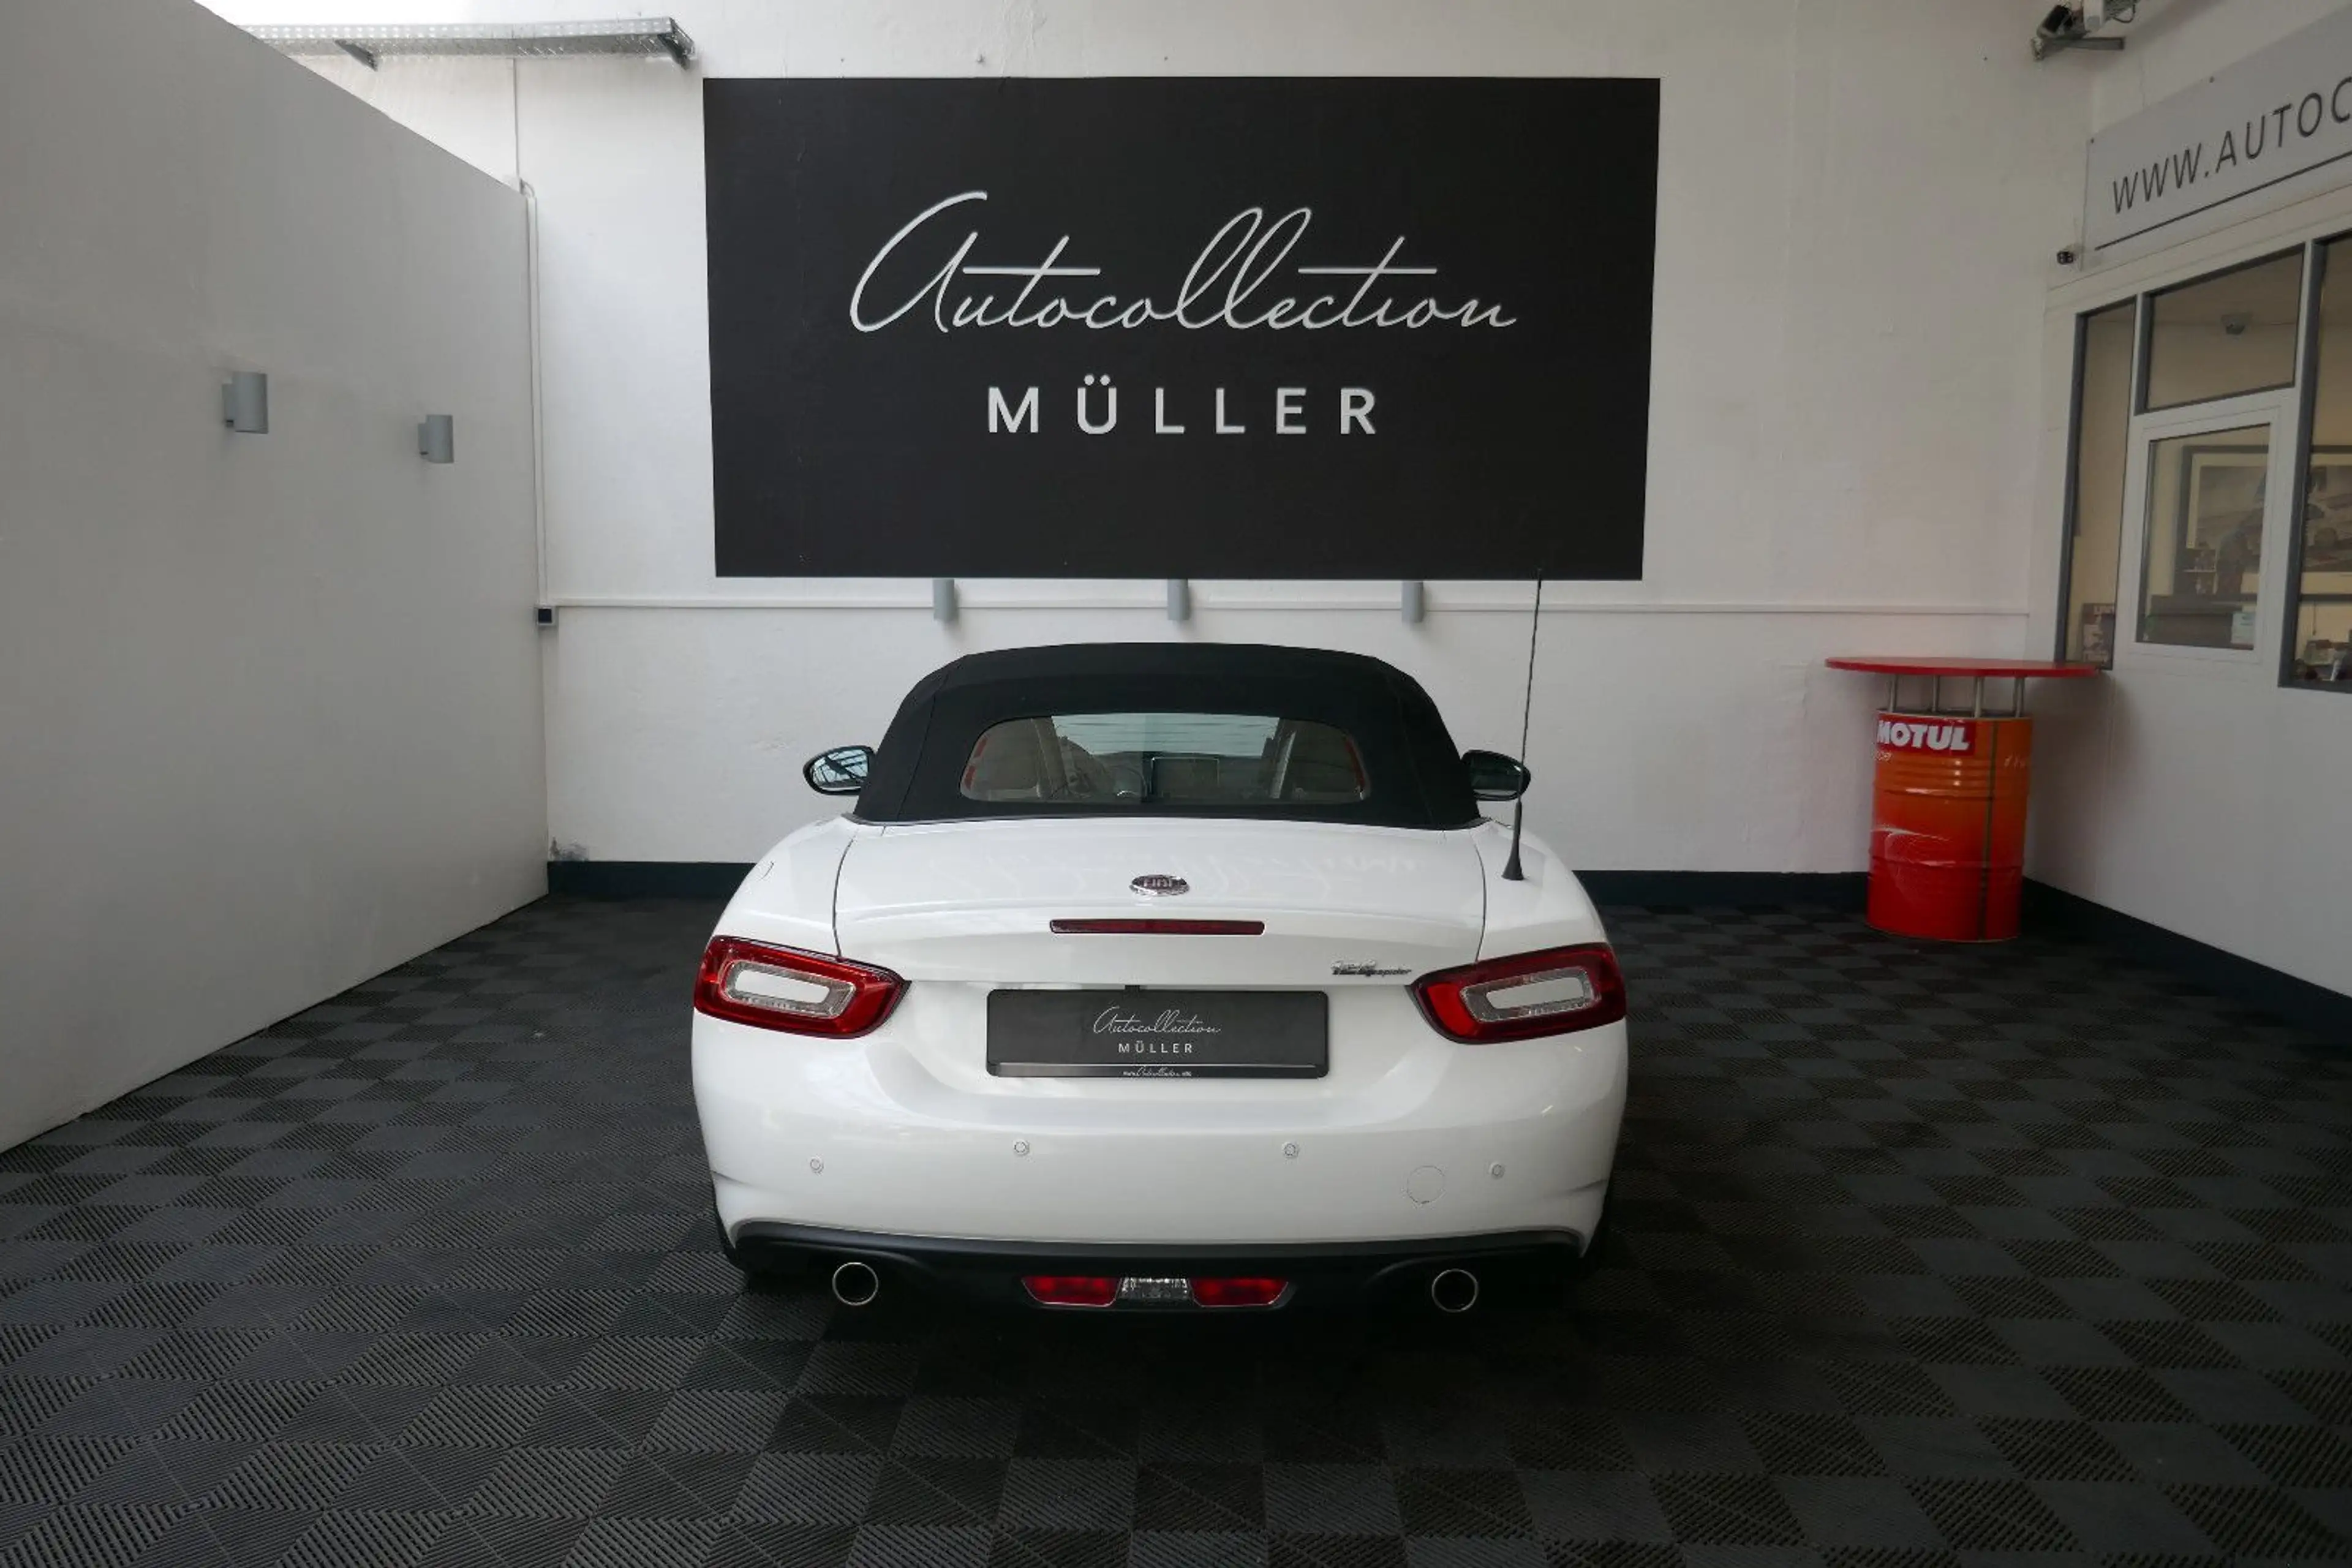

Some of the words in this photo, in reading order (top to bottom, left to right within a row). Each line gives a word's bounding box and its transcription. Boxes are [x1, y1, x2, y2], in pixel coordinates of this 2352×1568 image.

[849, 191, 1518, 333] Autocollection
[987, 374, 1376, 435] MÜLLER
[1877, 720, 1970, 751] MOTUL
[1093, 1005, 1222, 1034] Autocollection
[1118, 1040, 1193, 1054] MÜLLER
